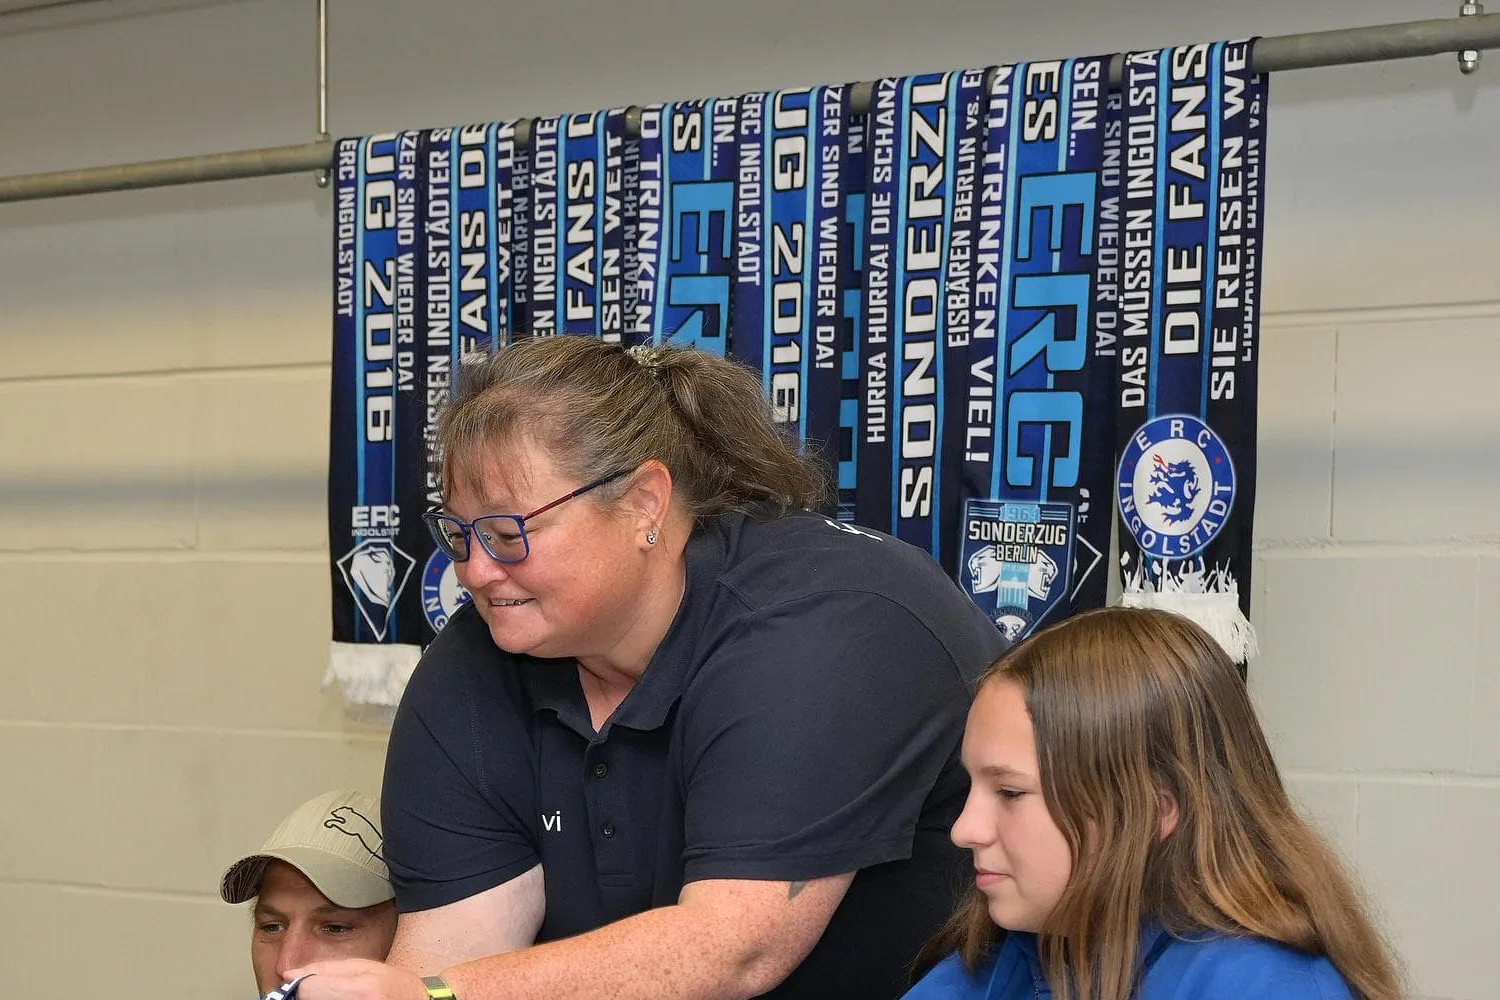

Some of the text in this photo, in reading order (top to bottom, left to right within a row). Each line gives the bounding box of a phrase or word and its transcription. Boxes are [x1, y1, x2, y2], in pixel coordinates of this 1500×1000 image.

[1023, 60, 1063, 142] ES
[1069, 61, 1100, 156] SEIN...
[338, 139, 357, 317] ERC INGOLSTADT
[567, 160, 595, 321] FANS
[604, 132, 623, 233] WEIT
[738, 93, 764, 286] ERC INGOLSTADT
[815, 85, 844, 369] ZER SIND WIEDER DA!
[871, 192, 891, 235] DIE
[954, 137, 976, 223] BERLIN
[1095, 120, 1121, 357] SIND WIEDER DA!
[1164, 43, 1210, 354] DIE FANS
[1216, 136, 1243, 308] REISEN
[397, 130, 417, 391] ZER SIND WIEDER DA!
[424, 150, 450, 346] INGOLSTÄDTER
[635, 154, 661, 334] TRINKEN
[868, 244, 889, 344] HURRA!
[945, 230, 971, 347] EISBÄREN
[965, 144, 1005, 462] TRINKEN VIEL!
[1119, 209, 1152, 336] MÜSSEN
[365, 260, 396, 442] 2016
[772, 223, 804, 423] 2016
[1122, 347, 1147, 408] DAS
[1211, 327, 1237, 400] SIE
[867, 352, 887, 443] HURRA
[1136, 420, 1211, 451] ERC
[969, 520, 1067, 545] SONDERZUG
[996, 545, 1038, 563] BERLIN
[1120, 481, 1231, 554] INGOLSTADT
